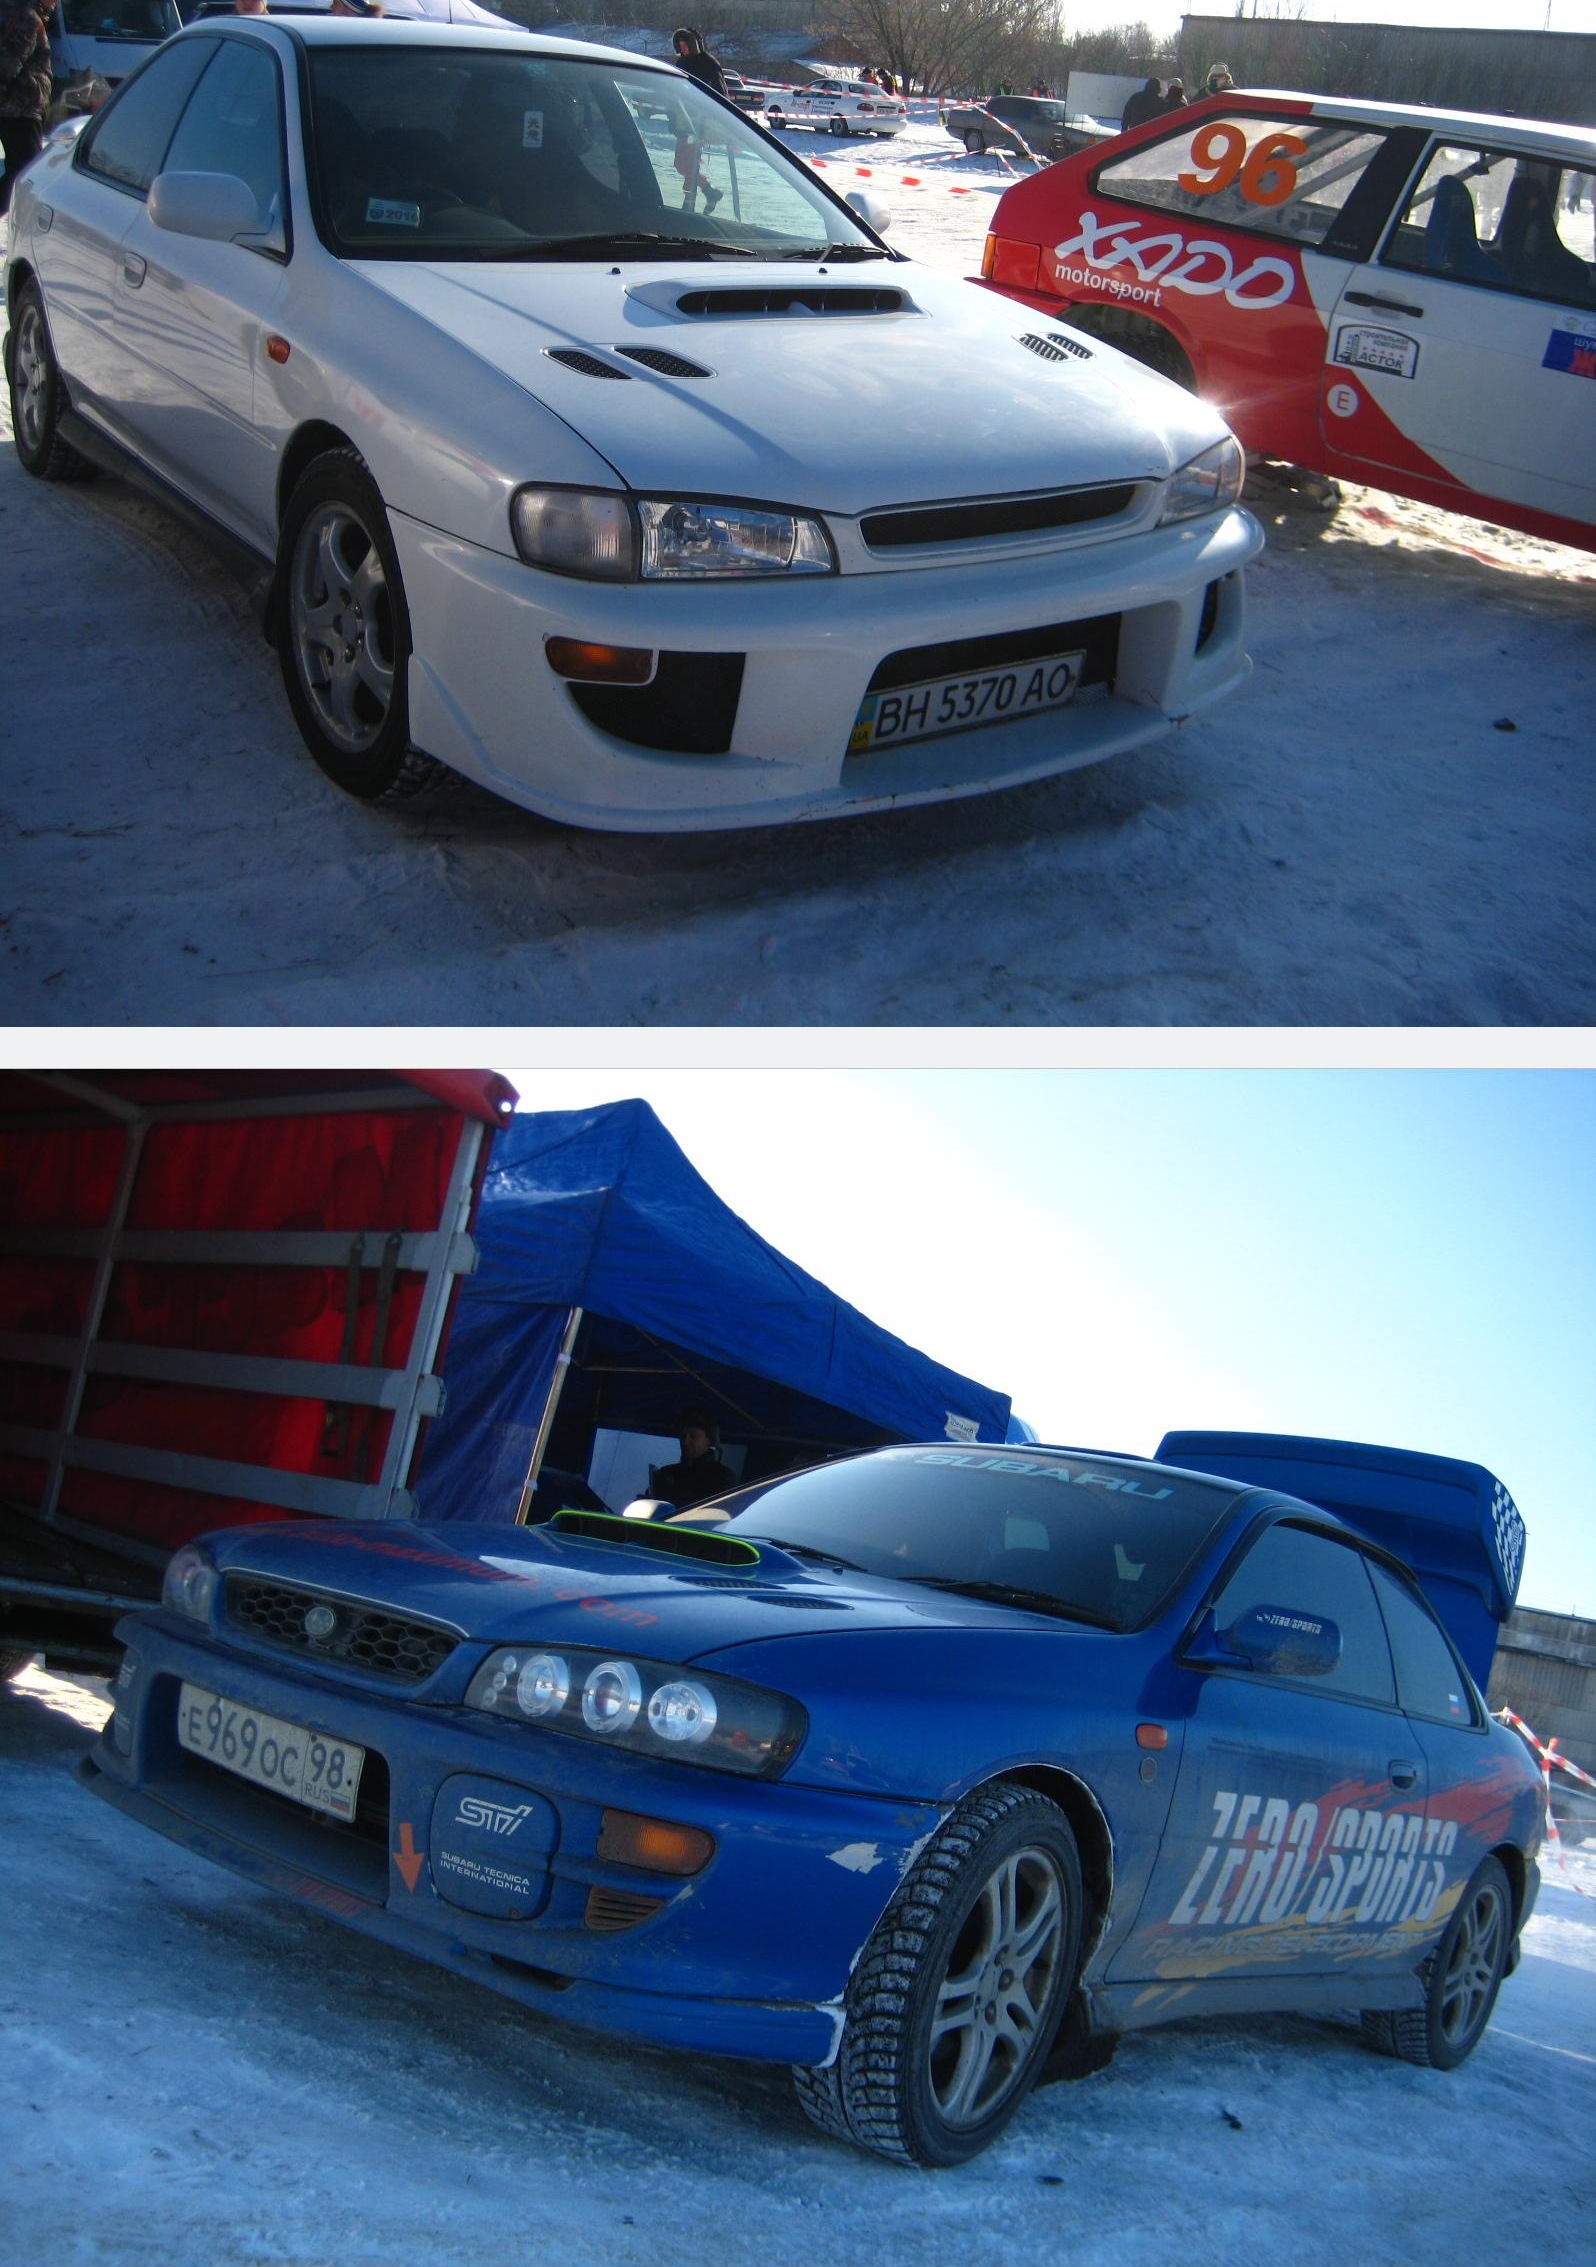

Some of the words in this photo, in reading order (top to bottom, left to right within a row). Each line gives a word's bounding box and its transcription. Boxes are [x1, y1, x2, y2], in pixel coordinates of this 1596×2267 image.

[1177, 123, 1308, 207] 96
[1055, 211, 1295, 310] XADO
[1055, 263, 1162, 307] motorsport
[1336, 390, 1351, 411] E
[875, 690, 931, 739] BH
[937, 673, 1017, 724] 5370
[1021, 663, 1071, 706] AO
[914, 1453, 1174, 1500] SUBARU
[310, 1742, 346, 1790] 98
[304, 1782, 332, 1804] RUS
[440, 1860, 530, 1895] INTERNATIONAL
[441, 1851, 481, 1872] SUBARU
[483, 1866, 531, 1886] TECNICA
